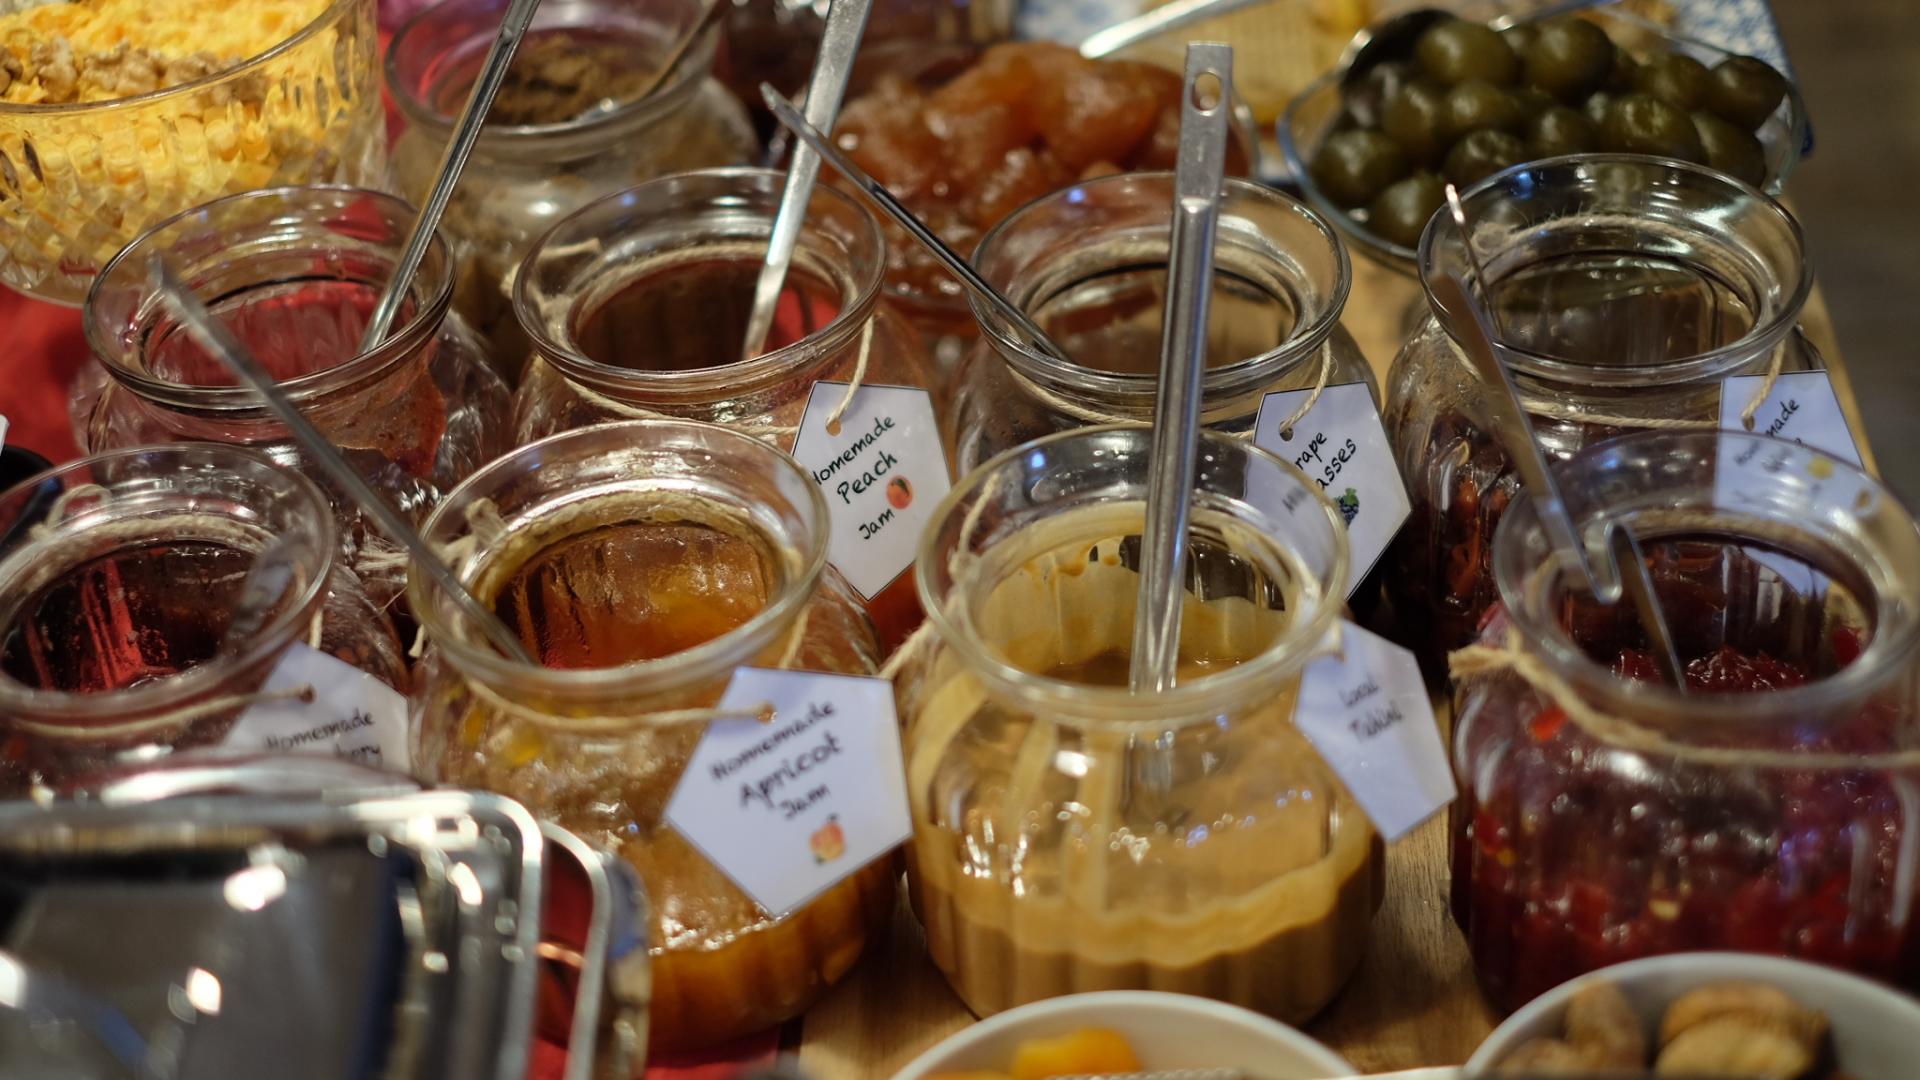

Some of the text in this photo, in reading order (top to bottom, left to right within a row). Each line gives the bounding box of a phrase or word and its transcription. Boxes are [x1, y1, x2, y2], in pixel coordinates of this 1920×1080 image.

[1294, 432, 1327, 471] rape
[836, 450, 899, 504] Peach
[858, 508, 895, 540] Jam
[266, 707, 375, 750] Homemade
[711, 702, 837, 781] Homemade
[741, 731, 842, 809] Apricot
[778, 784, 830, 820] Jam
